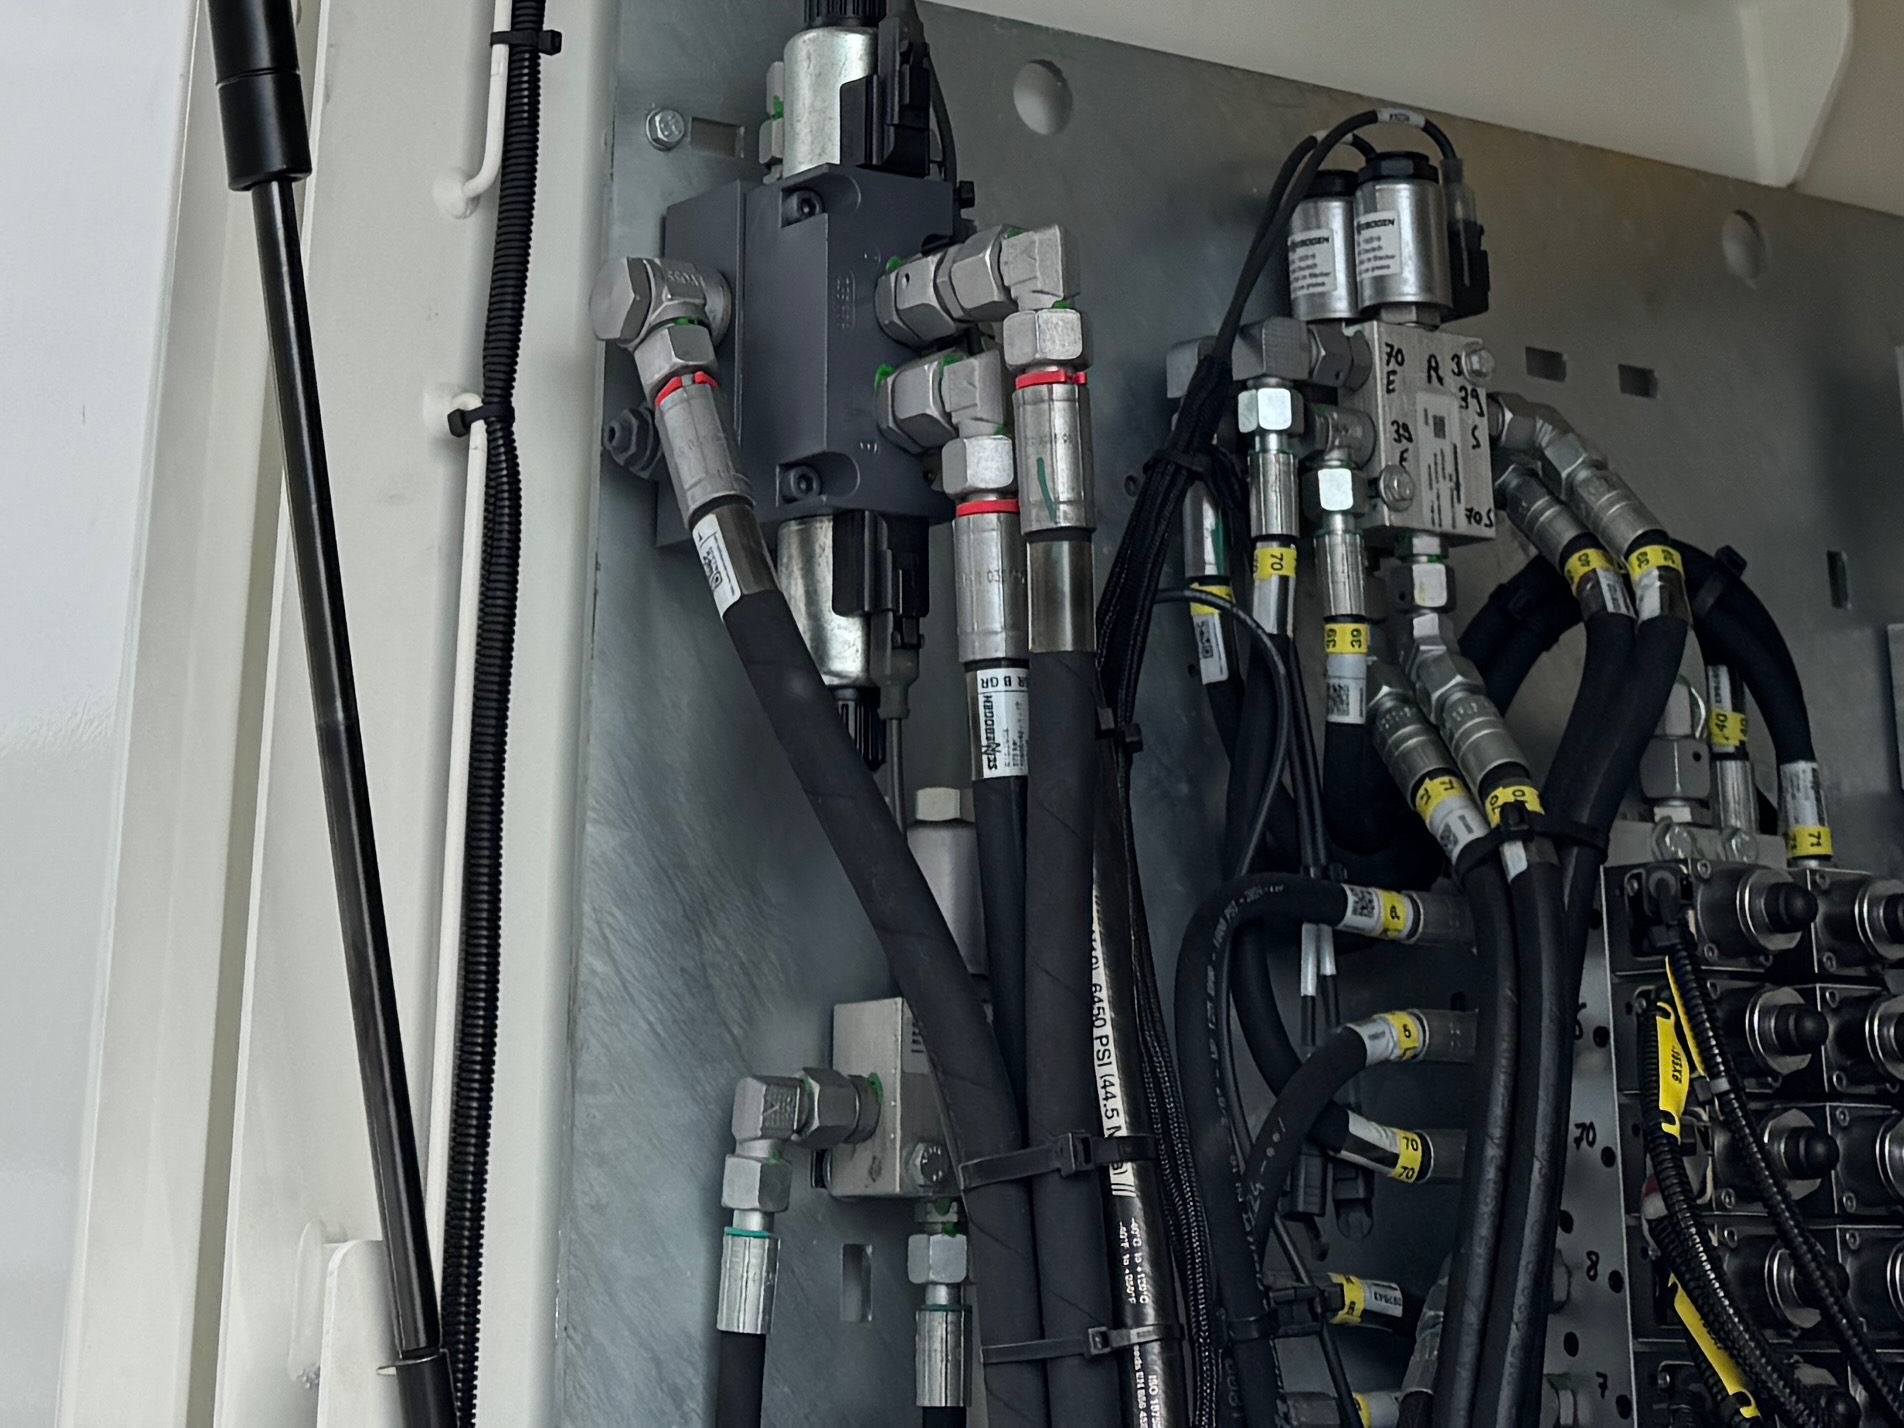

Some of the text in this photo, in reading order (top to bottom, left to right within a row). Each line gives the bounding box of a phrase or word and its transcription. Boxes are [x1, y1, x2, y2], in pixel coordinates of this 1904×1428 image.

[1385, 342, 1405, 366] 70
[1270, 552, 1284, 571] 70
[1350, 628, 1362, 649] 39
[1715, 713, 1728, 732] 40
[1808, 831, 1822, 848] 71
[1095, 1036, 1112, 1068] PSI
[1100, 1073, 1120, 1120] (44.5
[1402, 1136, 1419, 1152] 70
[1574, 1121, 1596, 1151] 70
[1398, 1165, 1415, 1180] 70
[1586, 1250, 1600, 1282] 8
